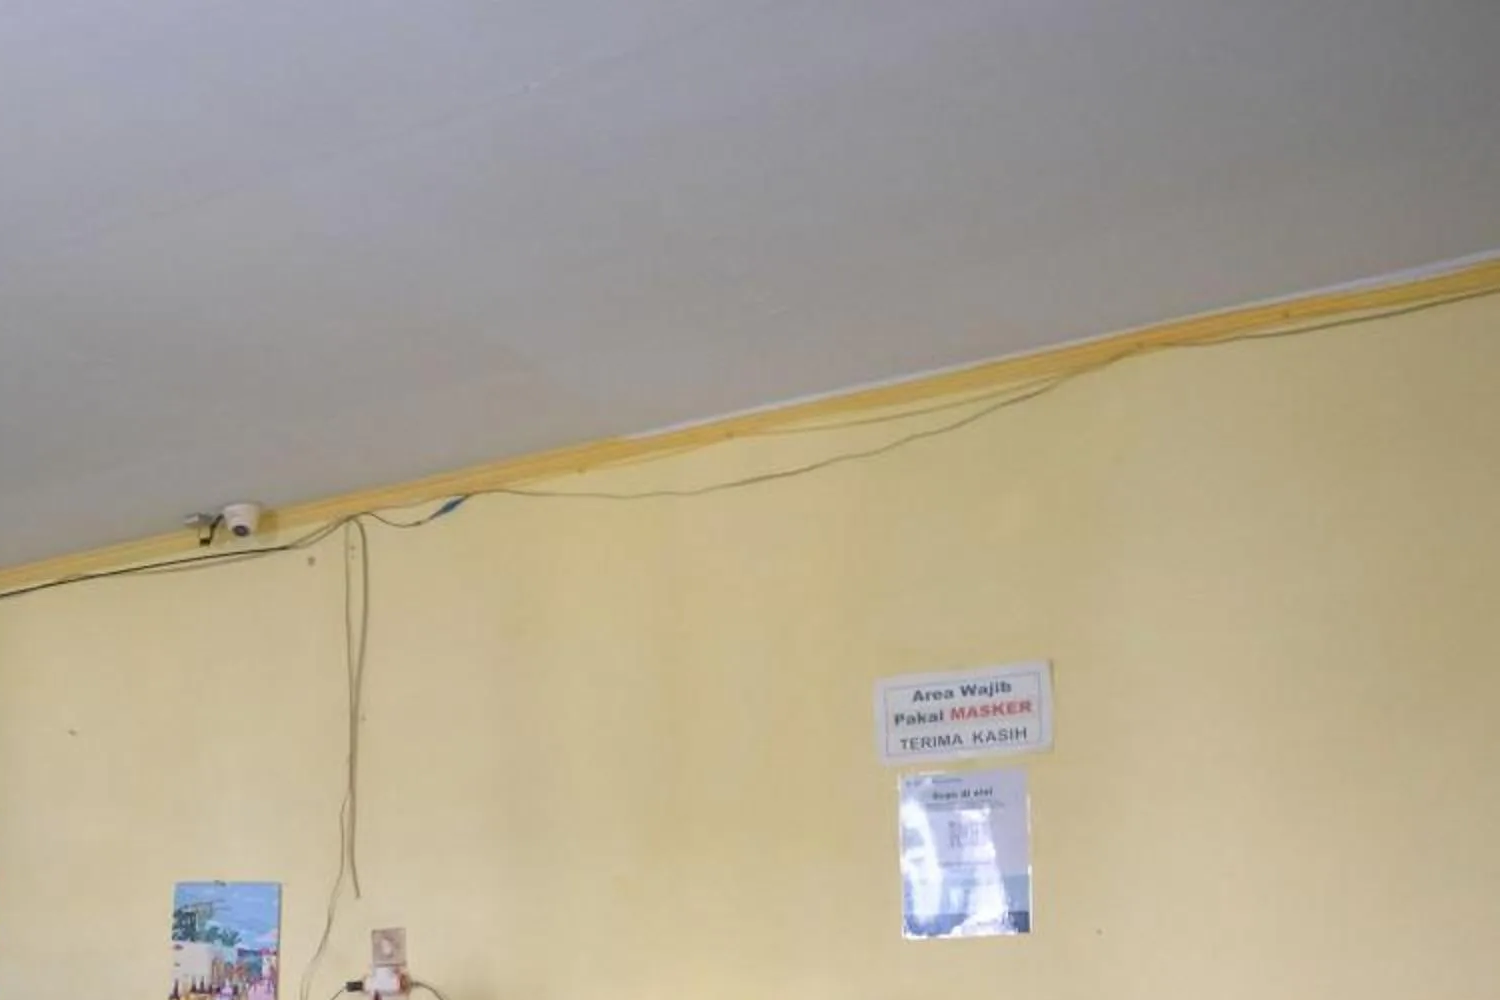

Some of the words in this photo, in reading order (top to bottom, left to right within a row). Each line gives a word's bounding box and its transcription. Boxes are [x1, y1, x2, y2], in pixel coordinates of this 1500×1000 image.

[912, 688, 955, 703] Area
[959, 680, 1012, 698] Wajib
[893, 710, 944, 727] Pakai
[949, 699, 1033, 721] MASKER
[899, 733, 964, 751] TERIMA
[971, 726, 1028, 745] KASIH
